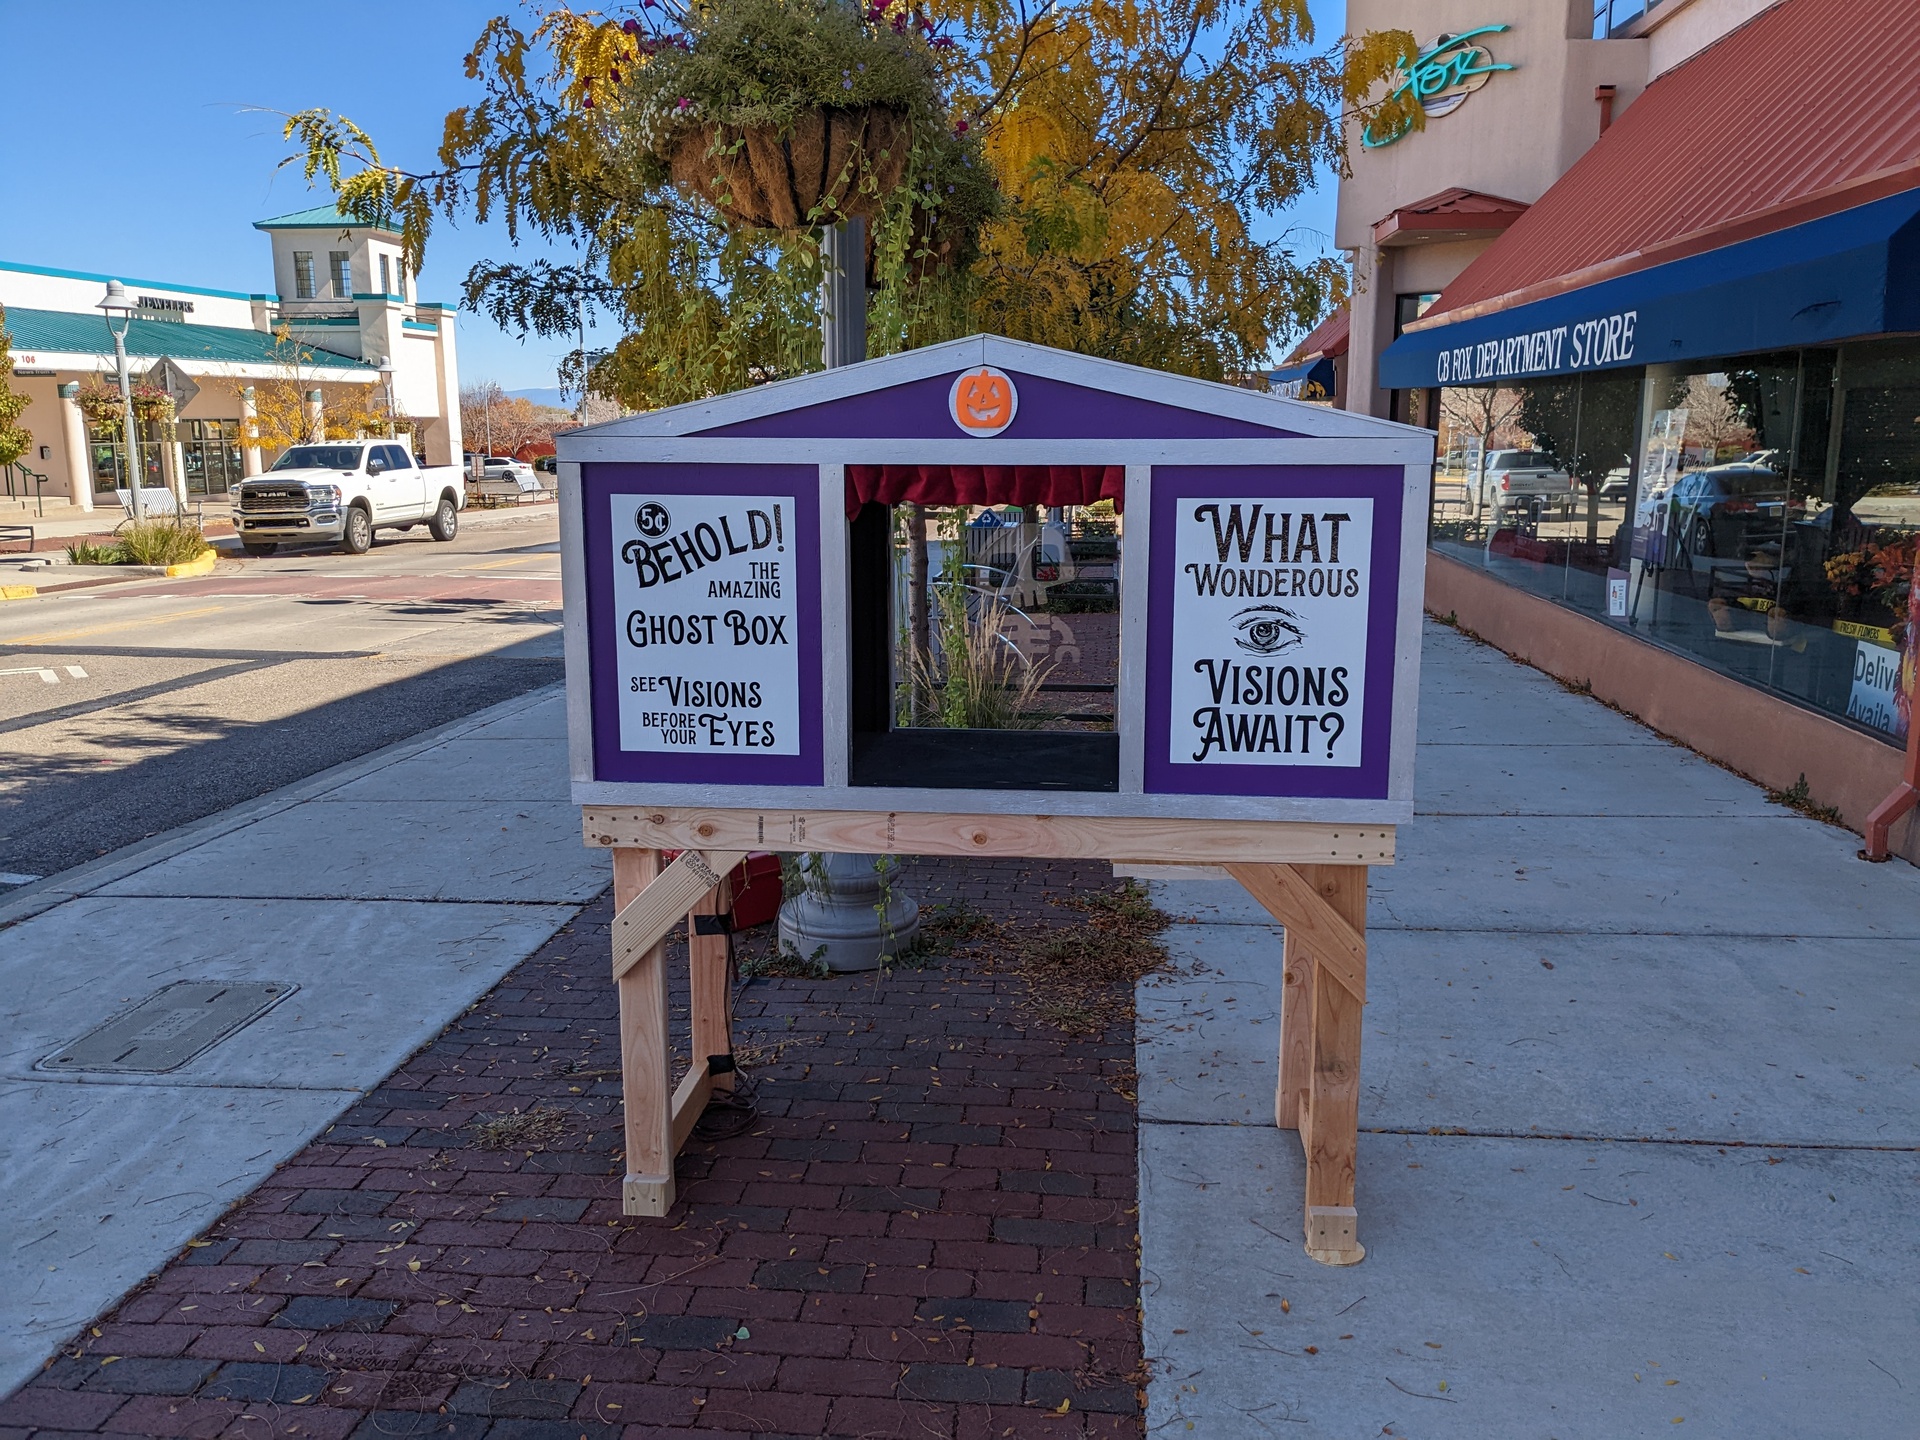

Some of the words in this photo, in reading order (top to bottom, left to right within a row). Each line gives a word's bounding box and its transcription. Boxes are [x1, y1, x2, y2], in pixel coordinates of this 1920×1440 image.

[137, 296, 194, 313] JEWELERS
[21, 355, 36, 364] 106
[1437, 350, 1450, 383] CB
[1452, 346, 1473, 382] FOX
[1475, 325, 1568, 379] DEPARTMENT
[1570, 310, 1638, 369] STORE
[621, 503, 785, 589] BEHOLD!
[1194, 504, 1351, 563] WHAT
[748, 562, 780, 579] THE
[1184, 563, 1359, 598] WONDEROUS
[707, 580, 781, 599] AMAZING
[626, 609, 718, 648] GHOST
[724, 609, 789, 646] BOX
[1840, 622, 1857, 637] FRESH
[1857, 625, 1880, 640] FLOWERS
[630, 676, 657, 692] SEE
[658, 676, 762, 708] VISIONS
[1194, 659, 1349, 707] VISIONS
[642, 712, 697, 728] BEFORE
[660, 729, 697, 745] YOUR
[698, 712, 775, 747] EYES
[1192, 707, 1345, 762] AWAIT?
